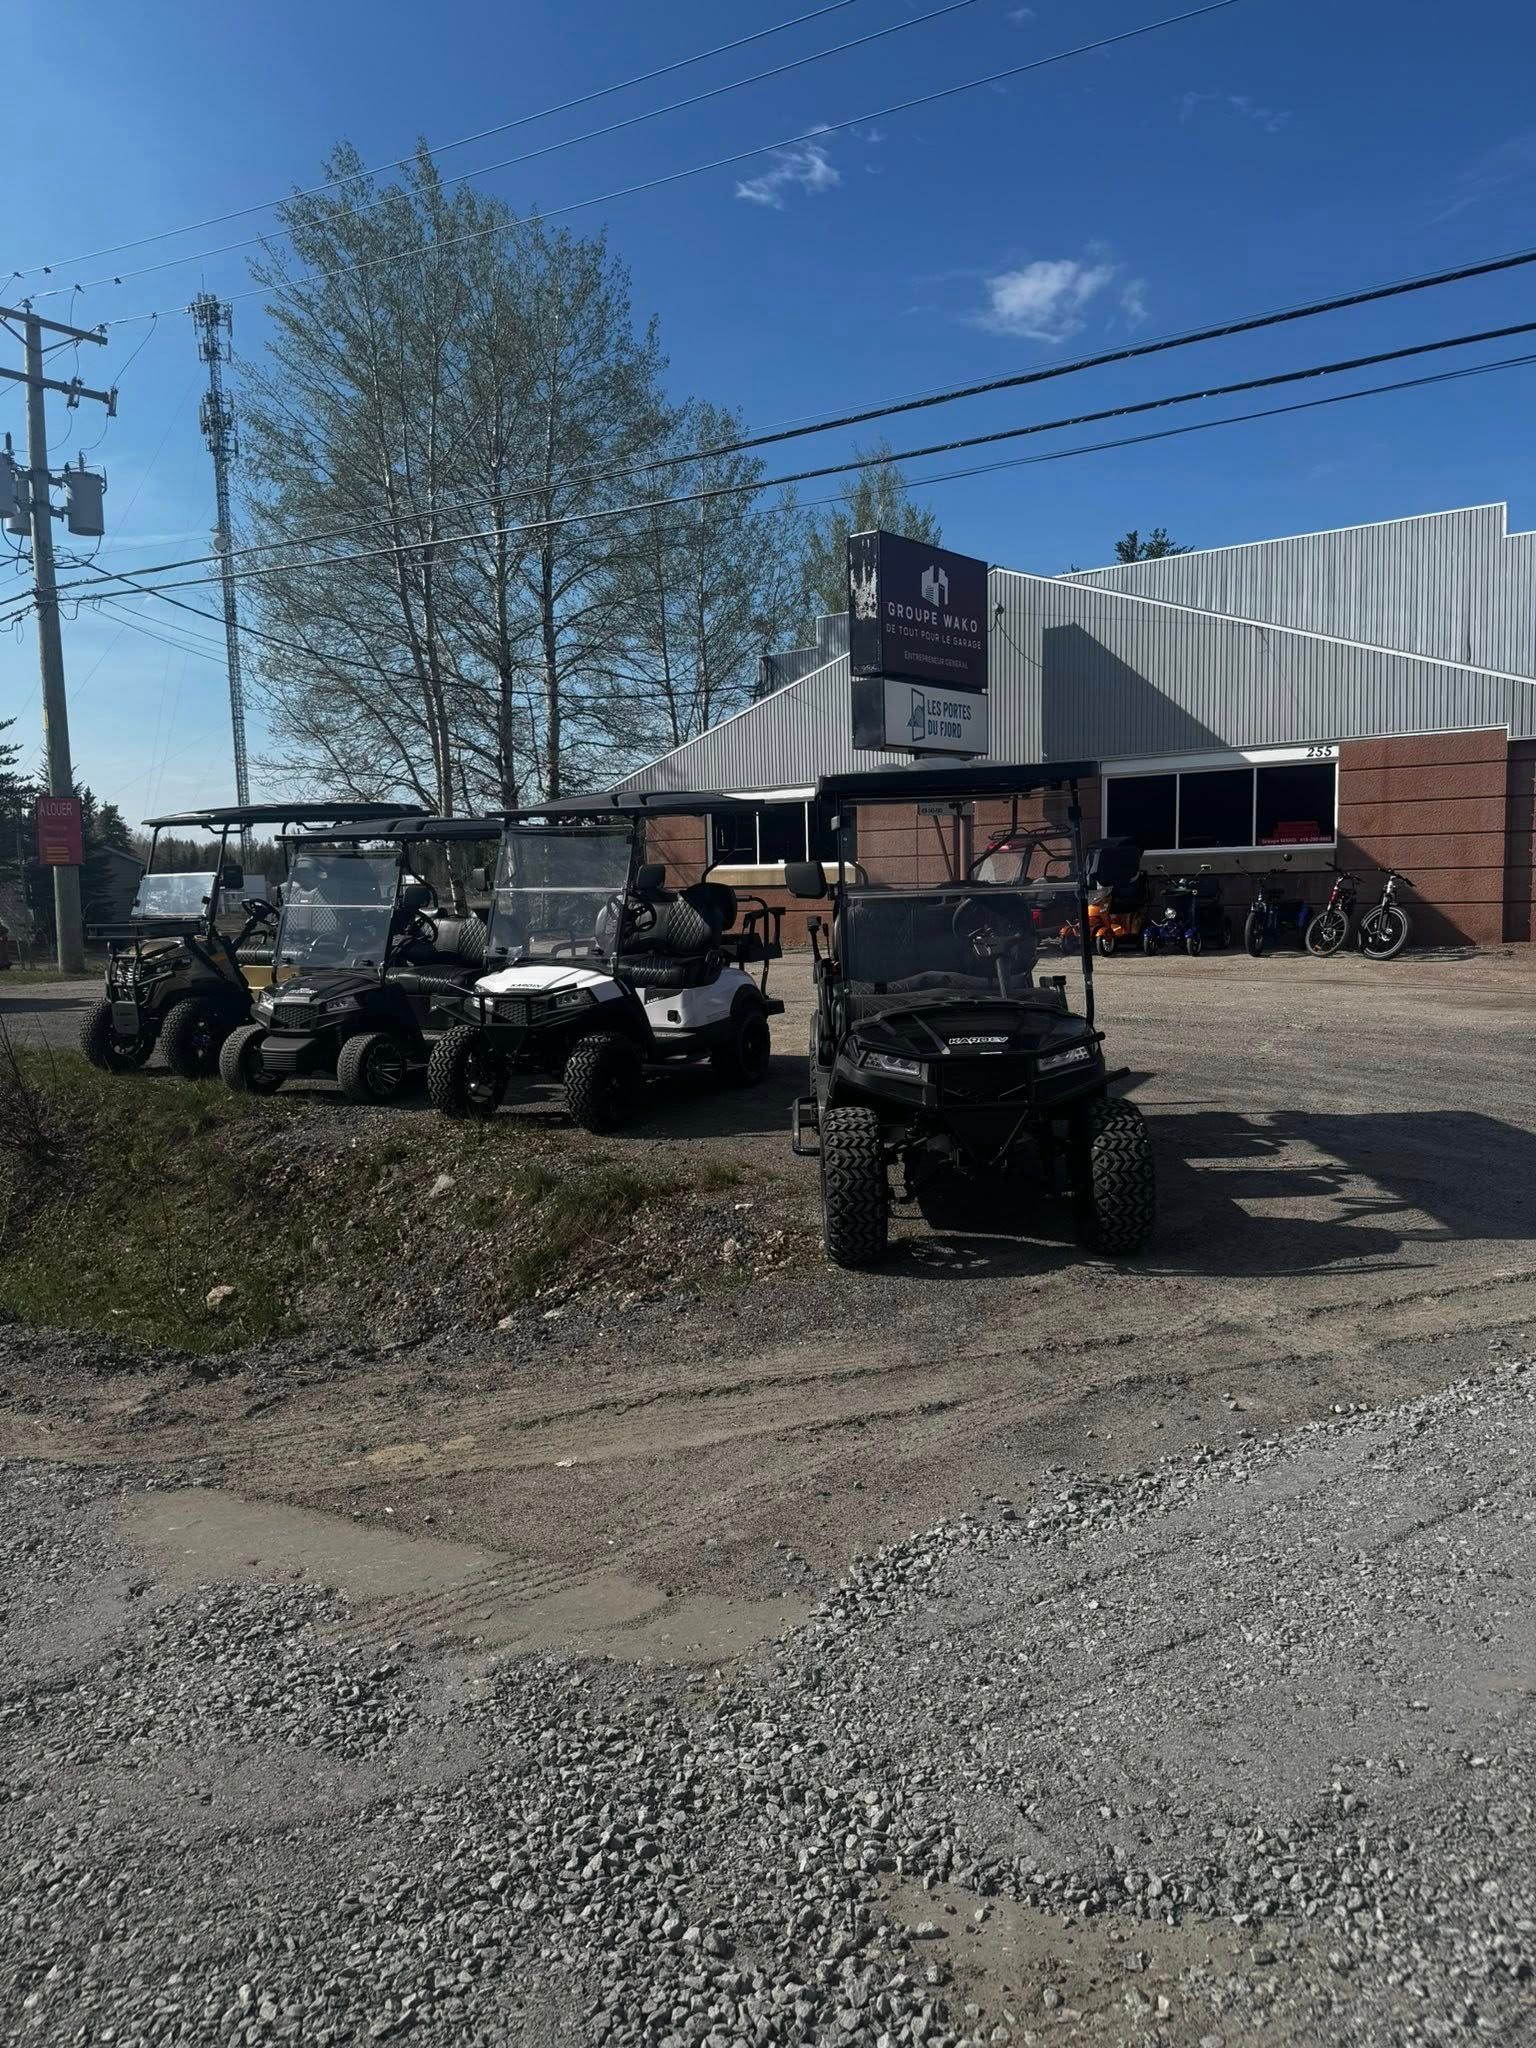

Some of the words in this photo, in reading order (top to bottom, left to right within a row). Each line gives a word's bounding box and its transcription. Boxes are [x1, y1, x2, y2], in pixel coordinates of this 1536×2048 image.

[888, 601, 938, 625] GROUPE
[943, 614, 978, 633] WAKO
[886, 623, 896, 633] DE
[898, 625, 918, 637] TOUT
[921, 630, 940, 642] POUR
[942, 635, 951, 645] LE
[953, 637, 982, 650] GARAGE
[928, 699, 942, 716] LES
[943, 702, 972, 721] PORTES
[928, 719, 938, 735] DU
[940, 721, 962, 738] FJORD
[1306, 746, 1332, 757] 255
[46, 802, 73, 816] LOUER
[948, 1036, 1009, 1045] KARDEV
